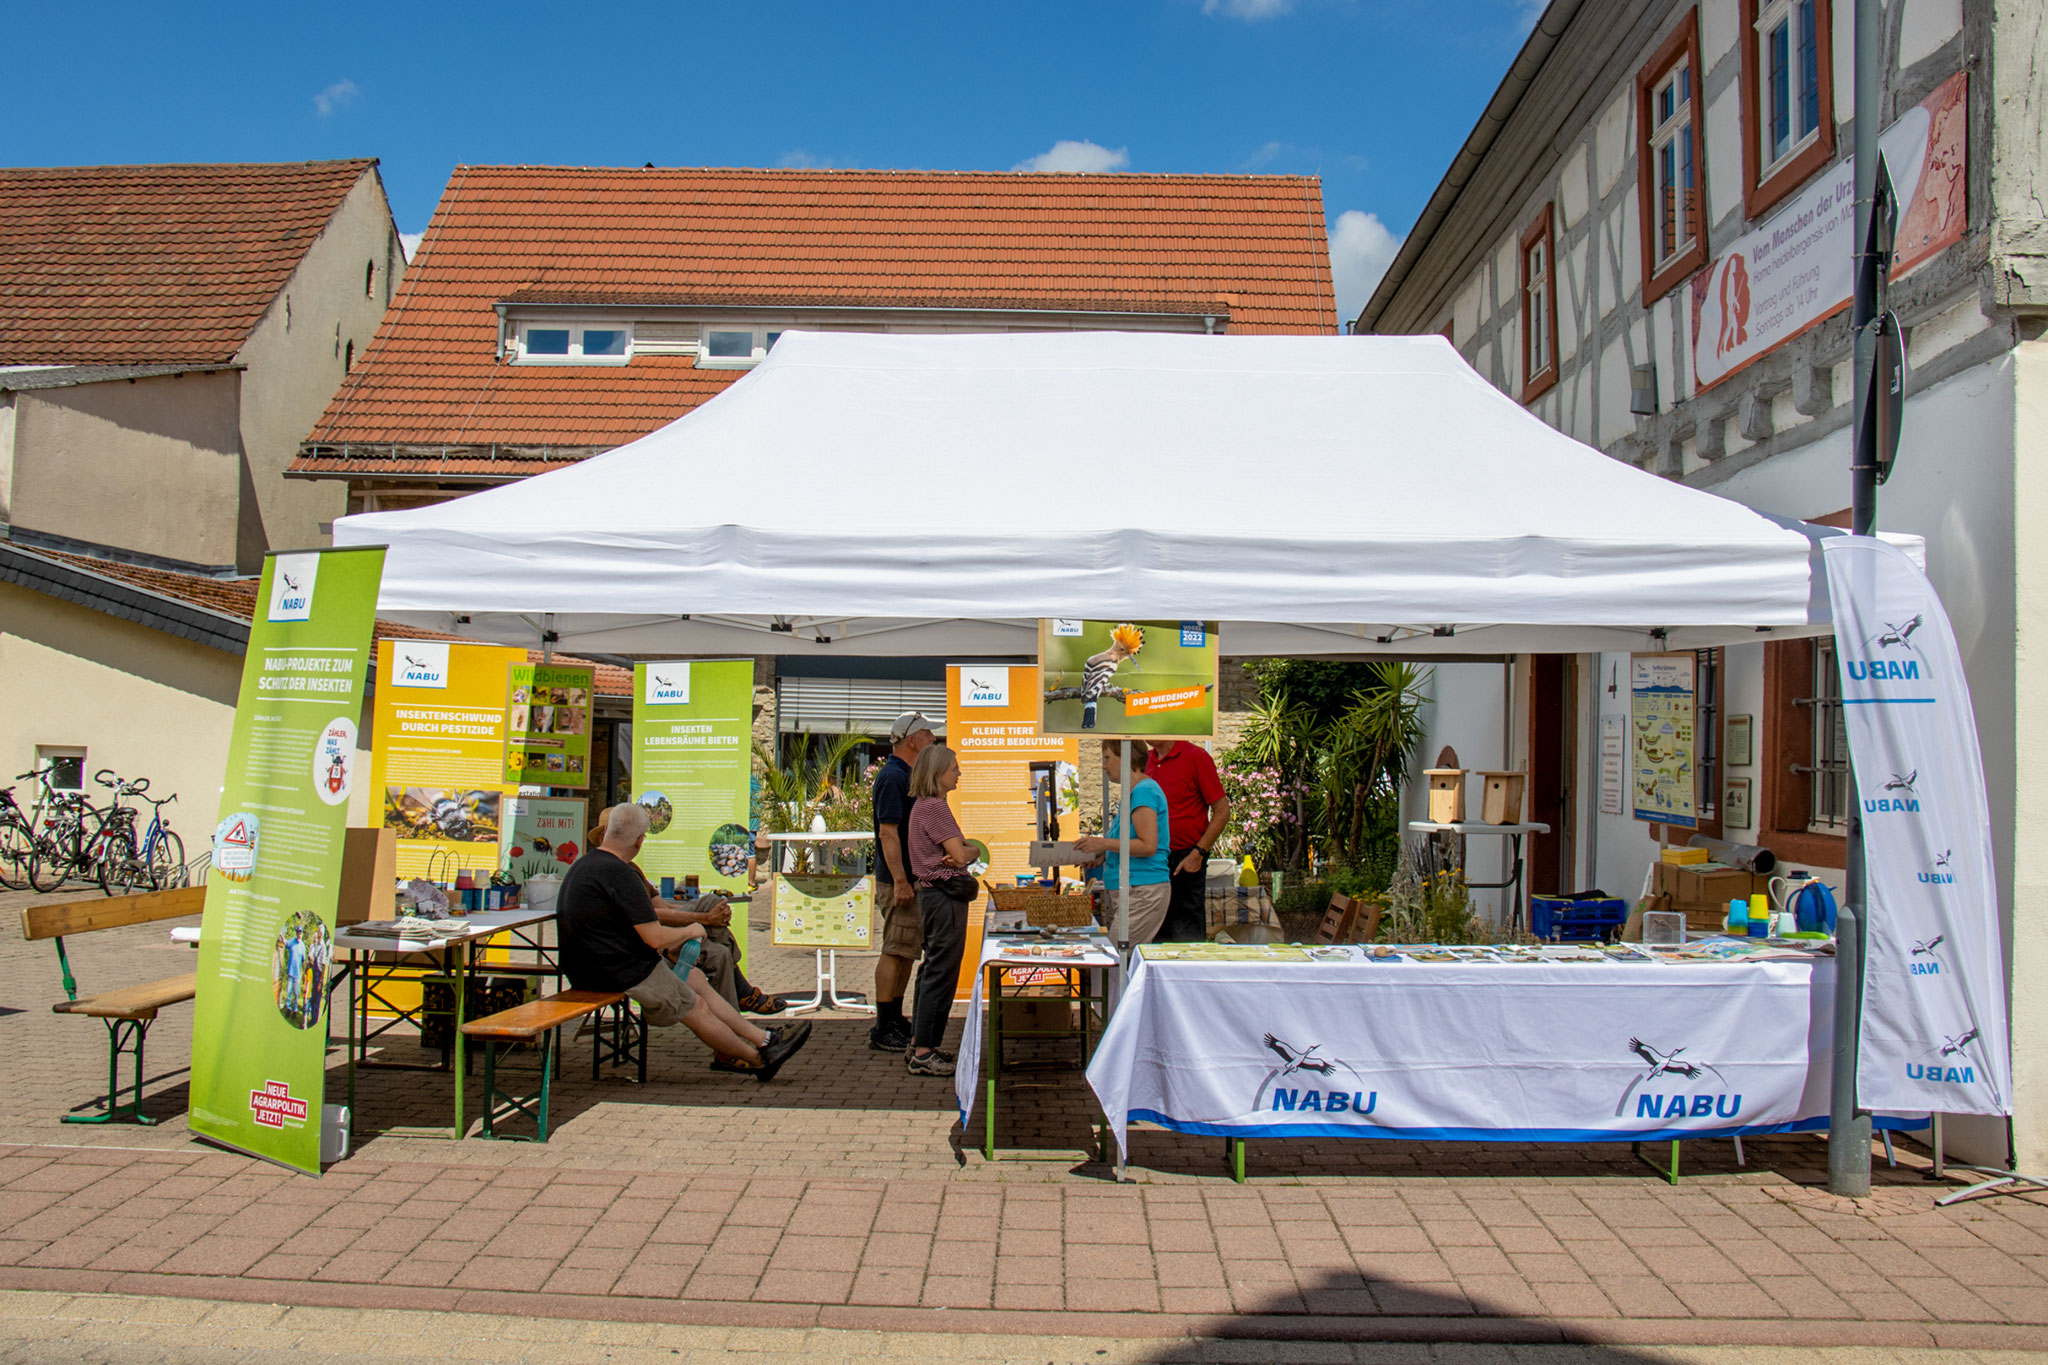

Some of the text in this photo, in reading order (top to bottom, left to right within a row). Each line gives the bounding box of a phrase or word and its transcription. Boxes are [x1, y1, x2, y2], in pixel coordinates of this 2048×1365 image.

[1752, 242, 1770, 264] Vom
[1772, 209, 1814, 250] Menschen
[1816, 195, 1833, 217] der
[1753, 265, 1771, 285] Homo
[1772, 225, 1824, 271] heidelbergensis
[1825, 216, 1839, 234] von
[1754, 265, 1819, 316] Vortrag und Führung
[1756, 287, 1818, 337] Sonntags ab 14 Uhr
[282, 597, 306, 611] NABU
[1183, 633, 1203, 641] 2022
[264, 657, 353, 673] NABU-PROJEKTE ZUM
[406, 671, 440, 682] NABU
[513, 669, 589, 684] Wildbienen
[258, 676, 353, 693] SCHUTZ DER INSEKTEN
[657, 690, 684, 698] NABU
[973, 693, 1002, 701] NABU
[1132, 690, 1199, 706] DER WIEDEHOPF
[396, 709, 502, 723] INSEKTENSCHWUND
[401, 722, 495, 735] DURCH PESTIZIDE
[671, 725, 713, 734] INSEKTEN
[972, 726, 1035, 735] KLEINE TIERE
[644, 734, 739, 745] LEBENSRÄUME BIETEN
[961, 737, 1064, 746] GROSSER BEDEUTUNG
[266, 1084, 286, 1098] NEUE
[252, 1095, 306, 1116] AGRARPOLITIK
[1271, 1087, 1378, 1115] NABU
[1636, 1094, 1742, 1119] NABU
[257, 1109, 282, 1124] JETZT!
